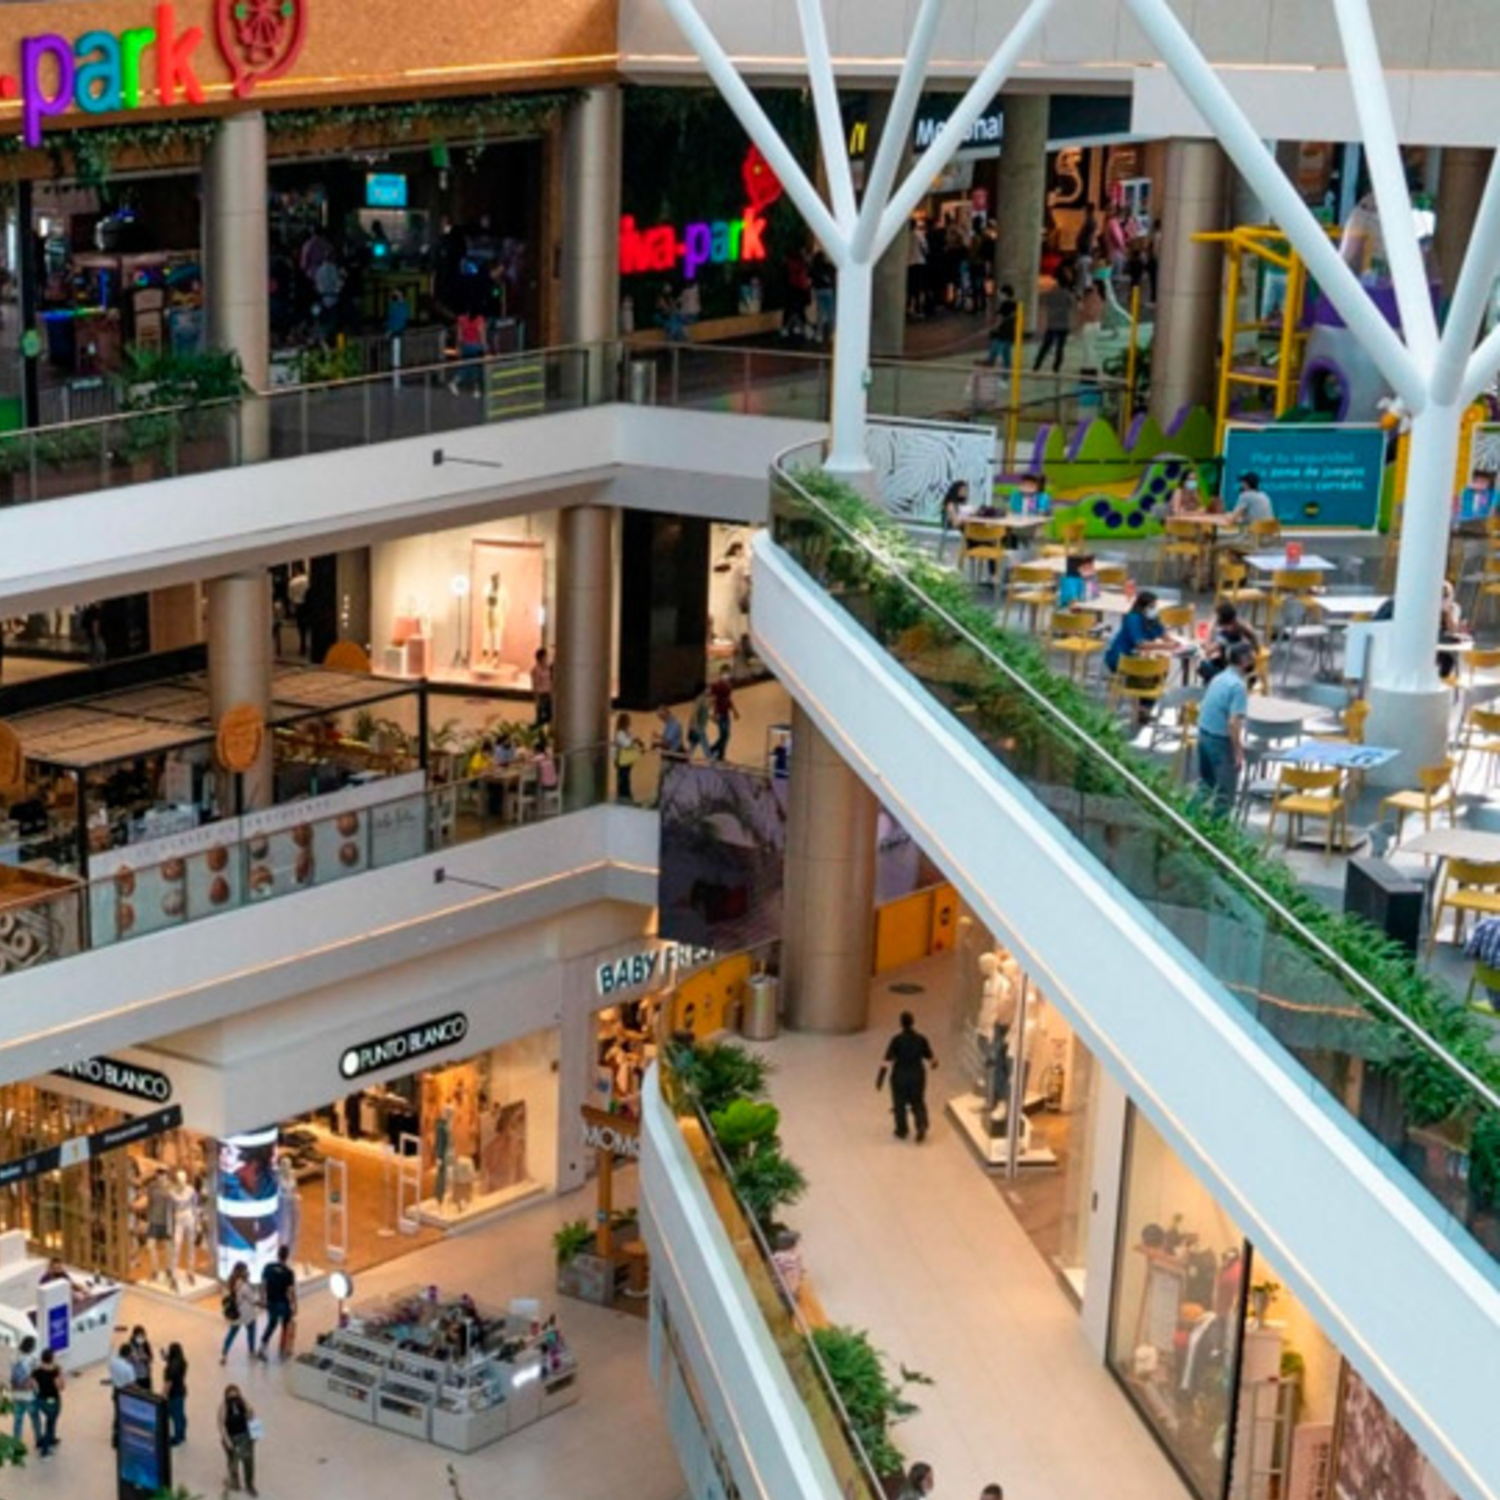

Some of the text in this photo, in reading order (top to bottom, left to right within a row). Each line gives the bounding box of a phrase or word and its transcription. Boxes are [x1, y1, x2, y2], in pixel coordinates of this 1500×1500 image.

[597, 951, 658, 997] BABY
[360, 1016, 466, 1072] PUNTO BLANCO
[104, 1064, 169, 1099] BLANCO
